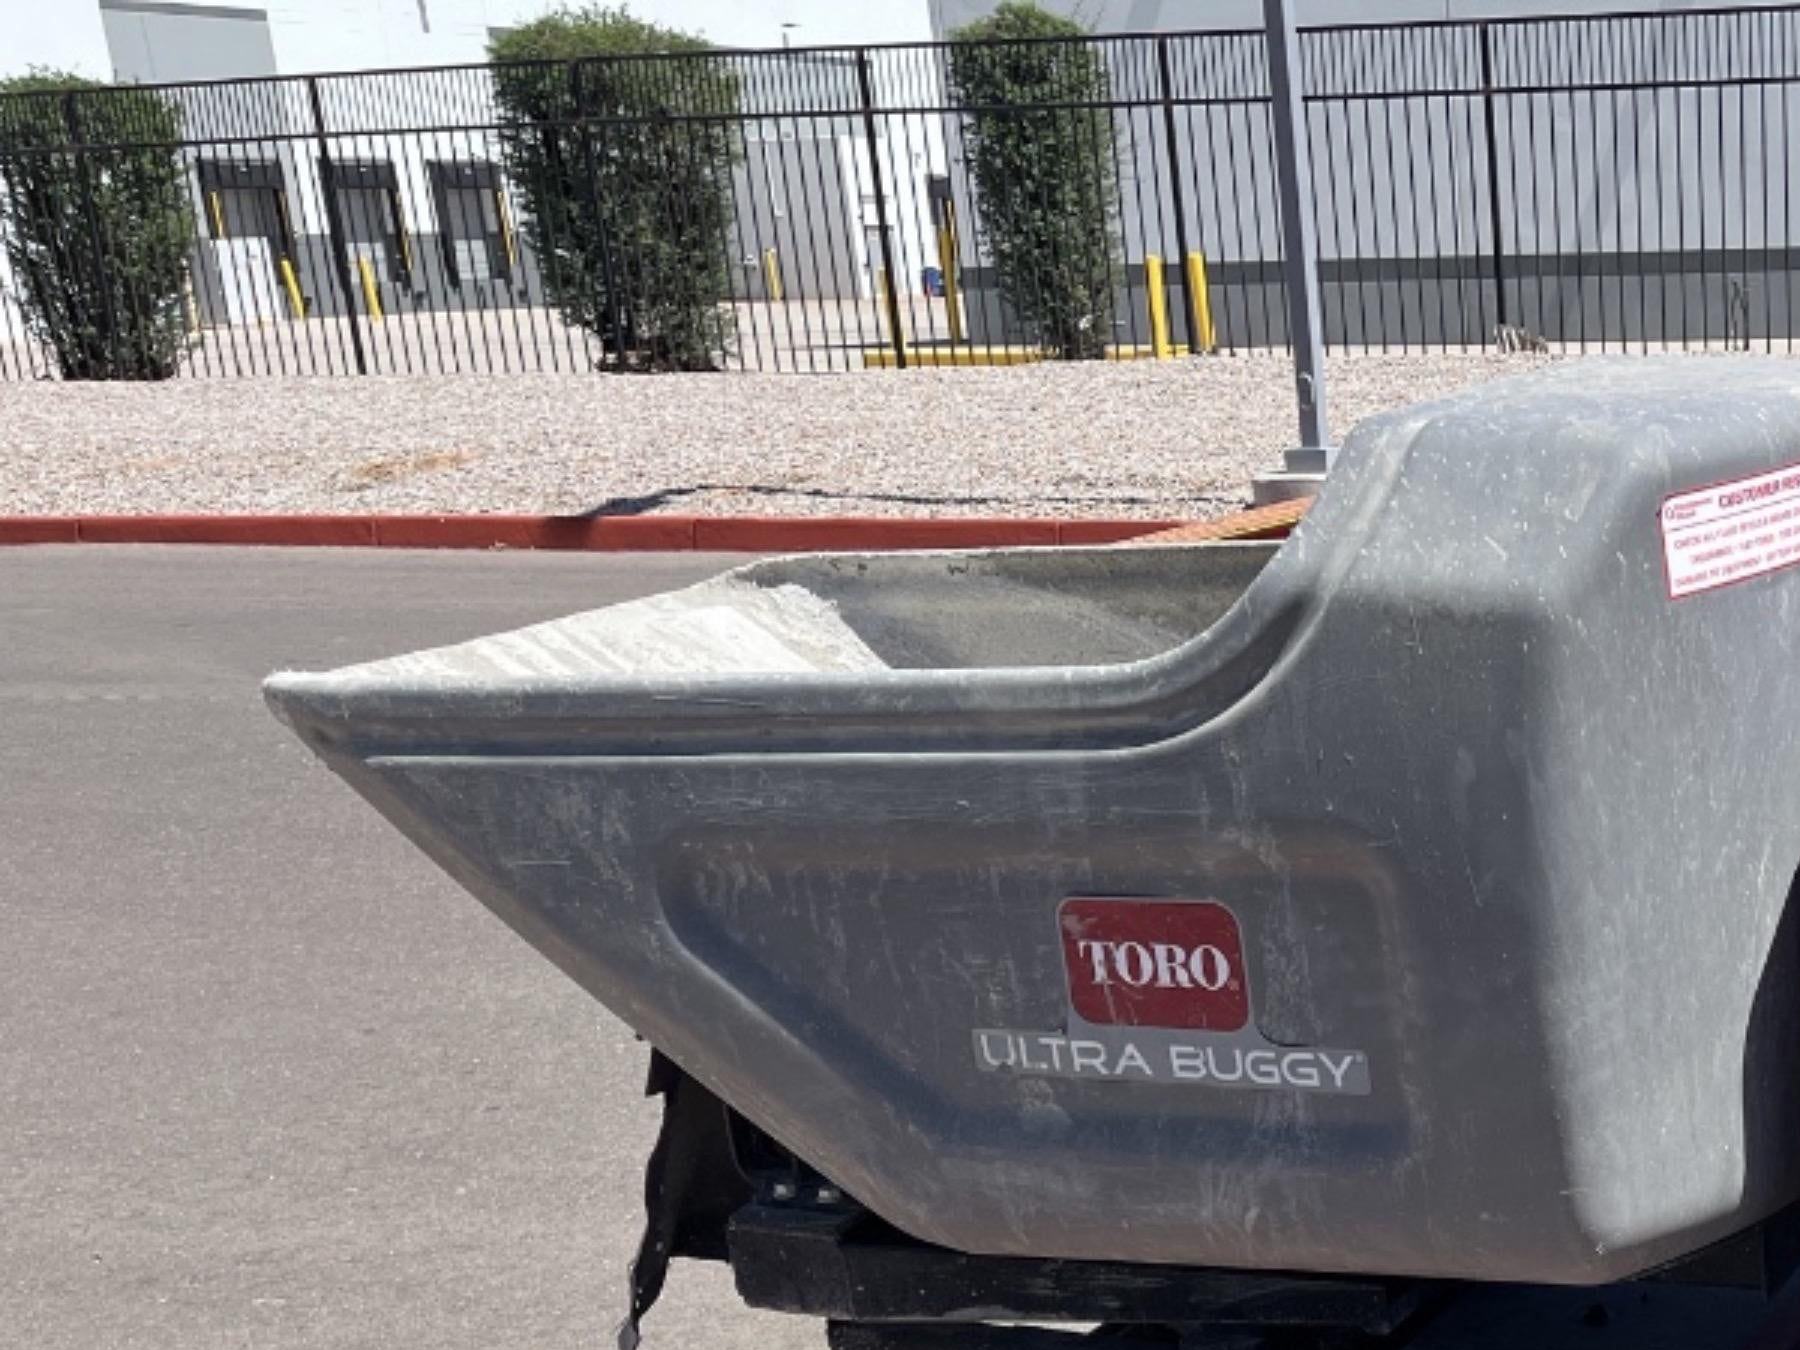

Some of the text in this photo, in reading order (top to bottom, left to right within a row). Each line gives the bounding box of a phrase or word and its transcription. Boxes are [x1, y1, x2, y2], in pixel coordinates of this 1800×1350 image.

[1079, 941, 1231, 991] TORO
[980, 1034, 1356, 1088] ULTRA BUGGY
